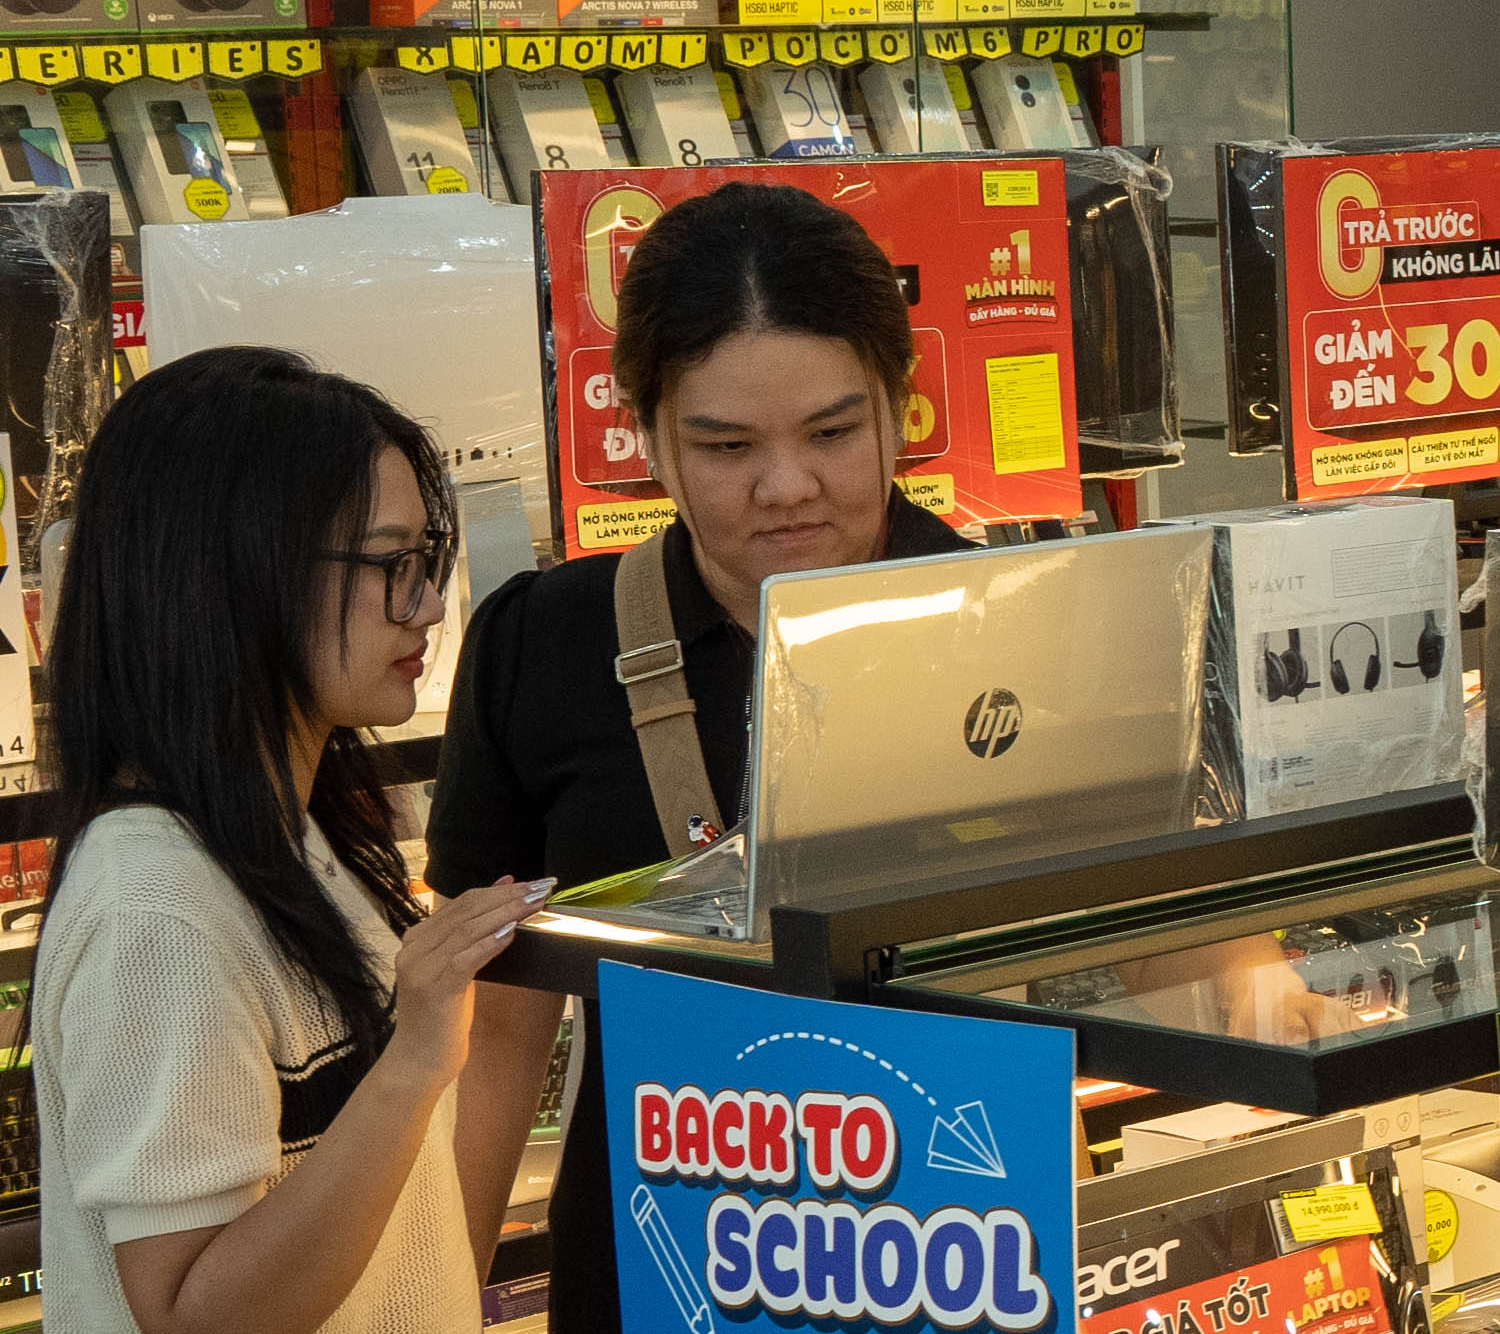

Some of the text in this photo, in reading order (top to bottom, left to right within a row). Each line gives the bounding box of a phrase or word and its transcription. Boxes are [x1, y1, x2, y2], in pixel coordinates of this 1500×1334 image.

[582, 0, 698, 11] ARCTIS NOVA WIRELESS
[745, 1, 798, 15] HS60 HAPTIC
[741, 27, 1134, 60] POCO M6 PRO
[1344, 211, 1474, 246] TRẢ TRƯỚC
[1392, 245, 1464, 278] KHÔNG
[1468, 244, 1500, 273] LÃI
[1314, 320, 1393, 365] GIẢM
[1329, 366, 1395, 410] ĐẾN
[1248, 576, 1306, 595] HAVIT
[638, 1091, 1040, 1321] BACK TO SCHOOL
[1077, 1238, 1180, 1305] acer
